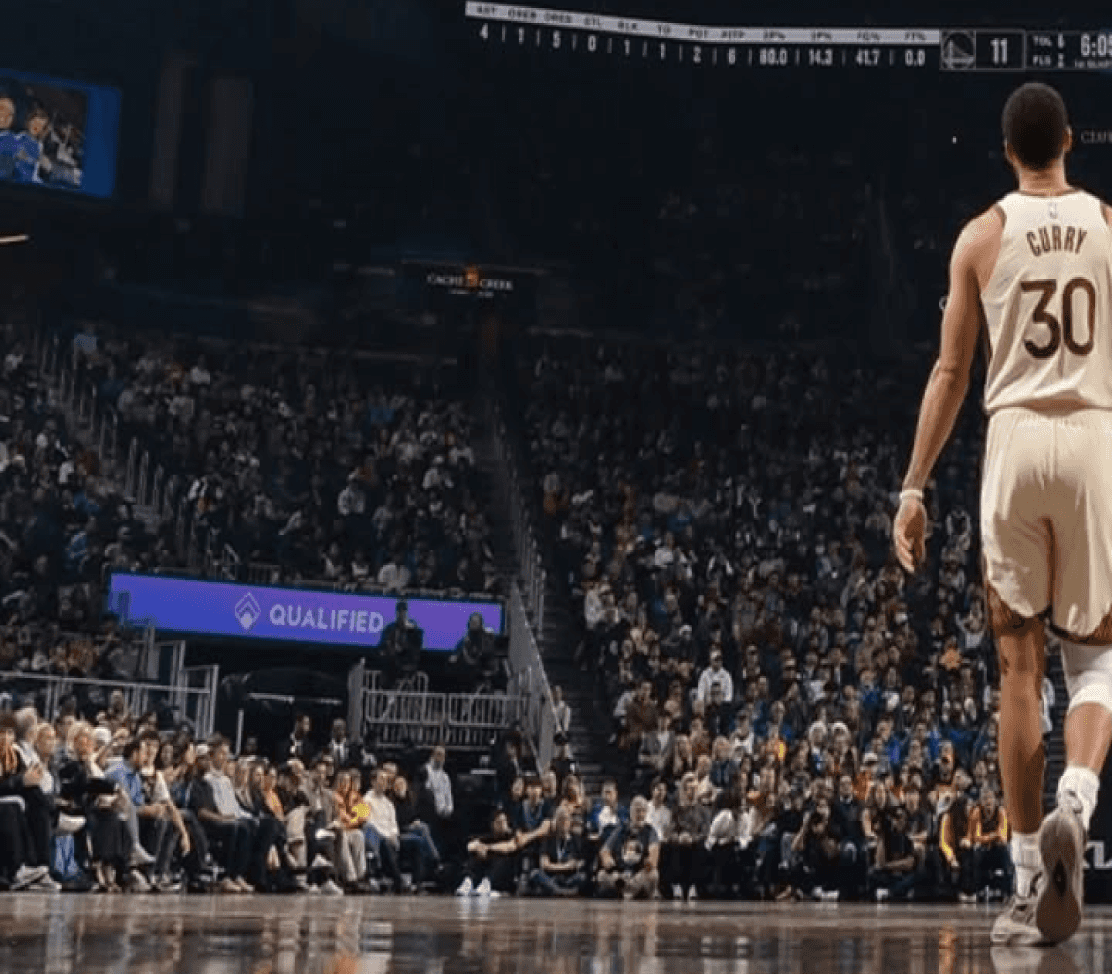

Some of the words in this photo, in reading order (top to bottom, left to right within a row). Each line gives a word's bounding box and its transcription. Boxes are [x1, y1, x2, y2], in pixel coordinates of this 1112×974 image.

[479, 23, 489, 40] 4
[518, 27, 525, 45] 1
[587, 34, 597, 52] 0
[624, 39, 631, 56] 1
[660, 42, 666, 60] 1
[692, 45, 702, 64] 2
[809, 47, 834, 66] 14.3
[855, 47, 881, 66] 41.7
[904, 47, 926, 66] 0.0
[990, 38, 1008, 65] 11
[1026, 225, 1088, 257] CURRY
[1020, 277, 1096, 360] 30
[269, 603, 384, 634] QUALIFIED
